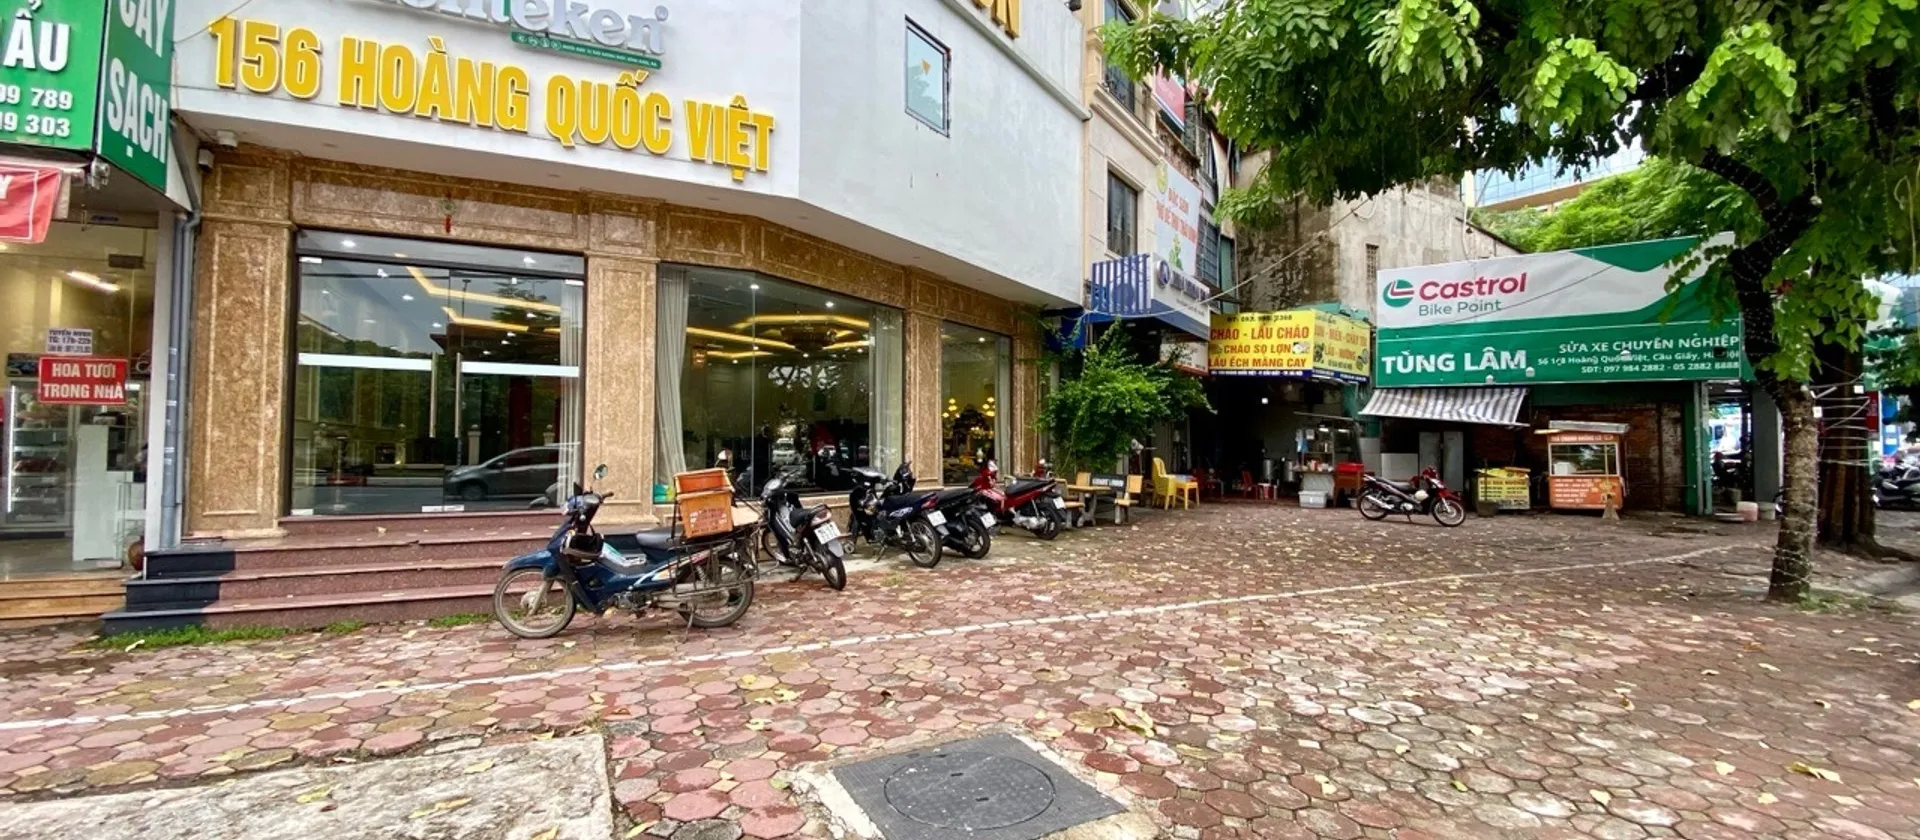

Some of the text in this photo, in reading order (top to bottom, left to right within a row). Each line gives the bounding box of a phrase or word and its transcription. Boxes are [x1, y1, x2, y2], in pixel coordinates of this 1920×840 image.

[396, 0, 664, 55] eken
[30, 88, 73, 110] 789
[107, 57, 168, 163] SẠCH
[209, 15, 775, 182] 156 HOÀNG QUỐC VIỆT
[0, 111, 70, 137] 9 303
[1419, 272, 1527, 301] Castrol
[1419, 299, 1502, 316] Bike Point
[1551, 356, 1566, 365] 18
[1601, 354, 1627, 364] Quố
[1559, 341, 1588, 354] SỬA
[1592, 341, 1609, 352] XE
[52, 363, 80, 378] HOA
[84, 362, 117, 378] TƯƠI
[1381, 346, 1527, 374] TÙNG LÂM
[43, 381, 124, 399] TRONG NHÀ
